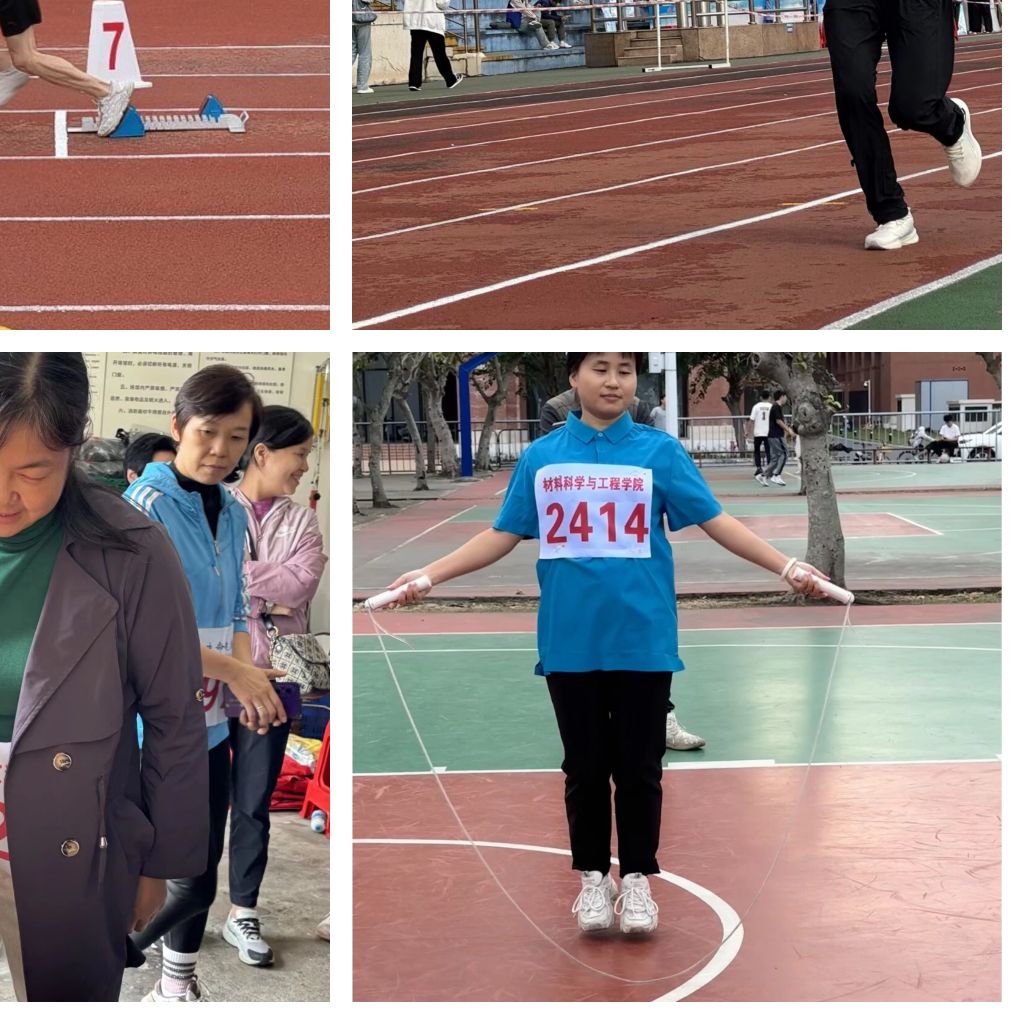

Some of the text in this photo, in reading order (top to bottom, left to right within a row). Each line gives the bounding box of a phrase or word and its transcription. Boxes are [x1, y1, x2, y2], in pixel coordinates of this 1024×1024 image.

[103, 22, 124, 70] 7
[543, 476, 644, 492] 材料科学与工程学院
[546, 501, 649, 544] 2414
